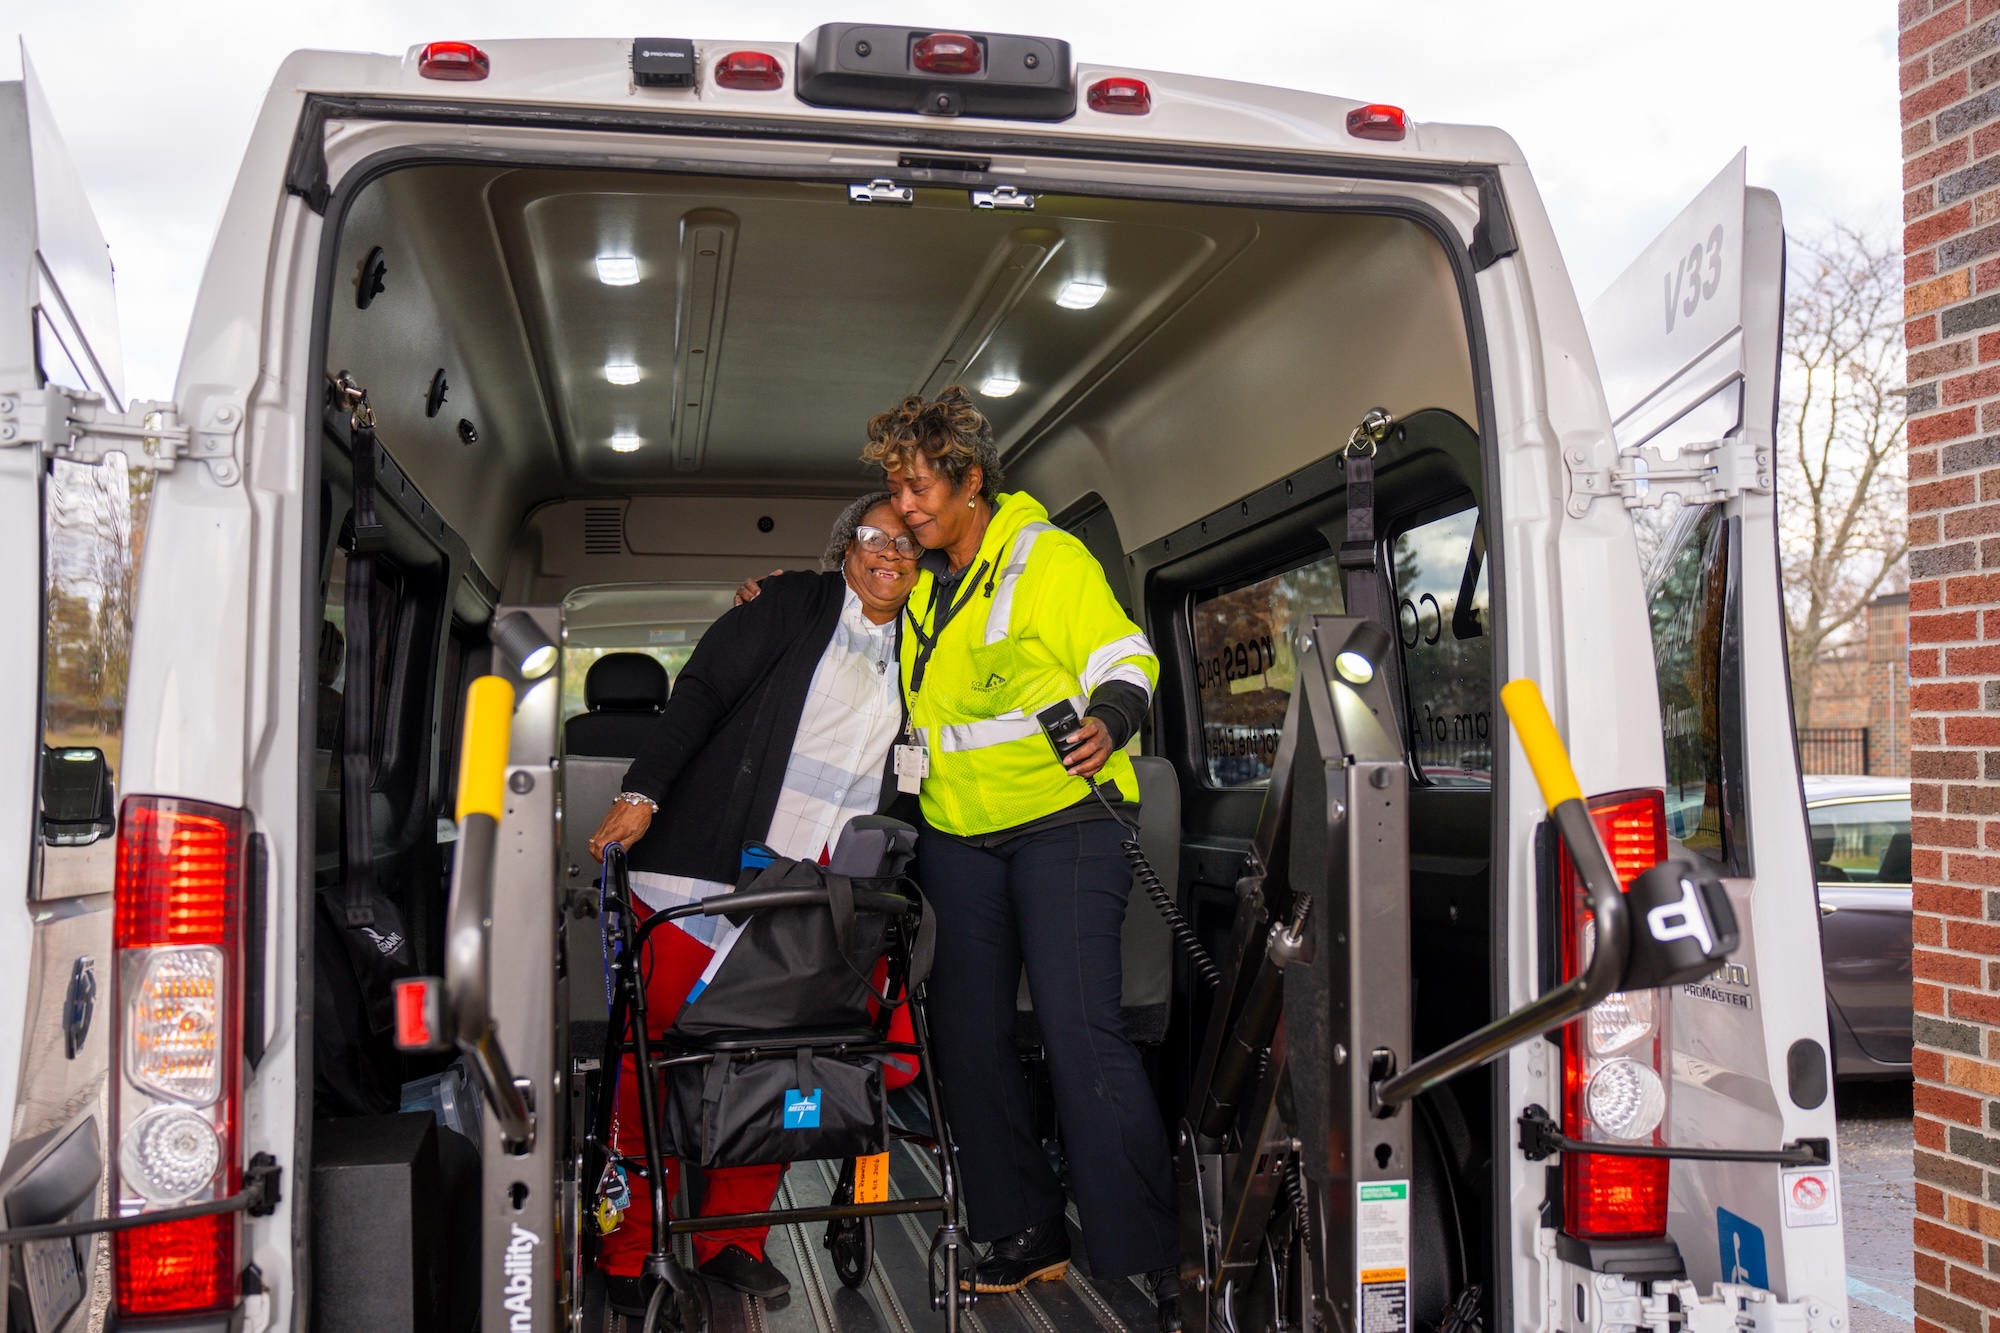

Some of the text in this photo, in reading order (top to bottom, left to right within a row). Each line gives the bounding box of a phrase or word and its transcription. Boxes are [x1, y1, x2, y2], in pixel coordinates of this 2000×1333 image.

[1663, 223, 1723, 335] V33
[787, 1103, 818, 1112] MEDLINE
[503, 1226, 540, 1333] nAbility
